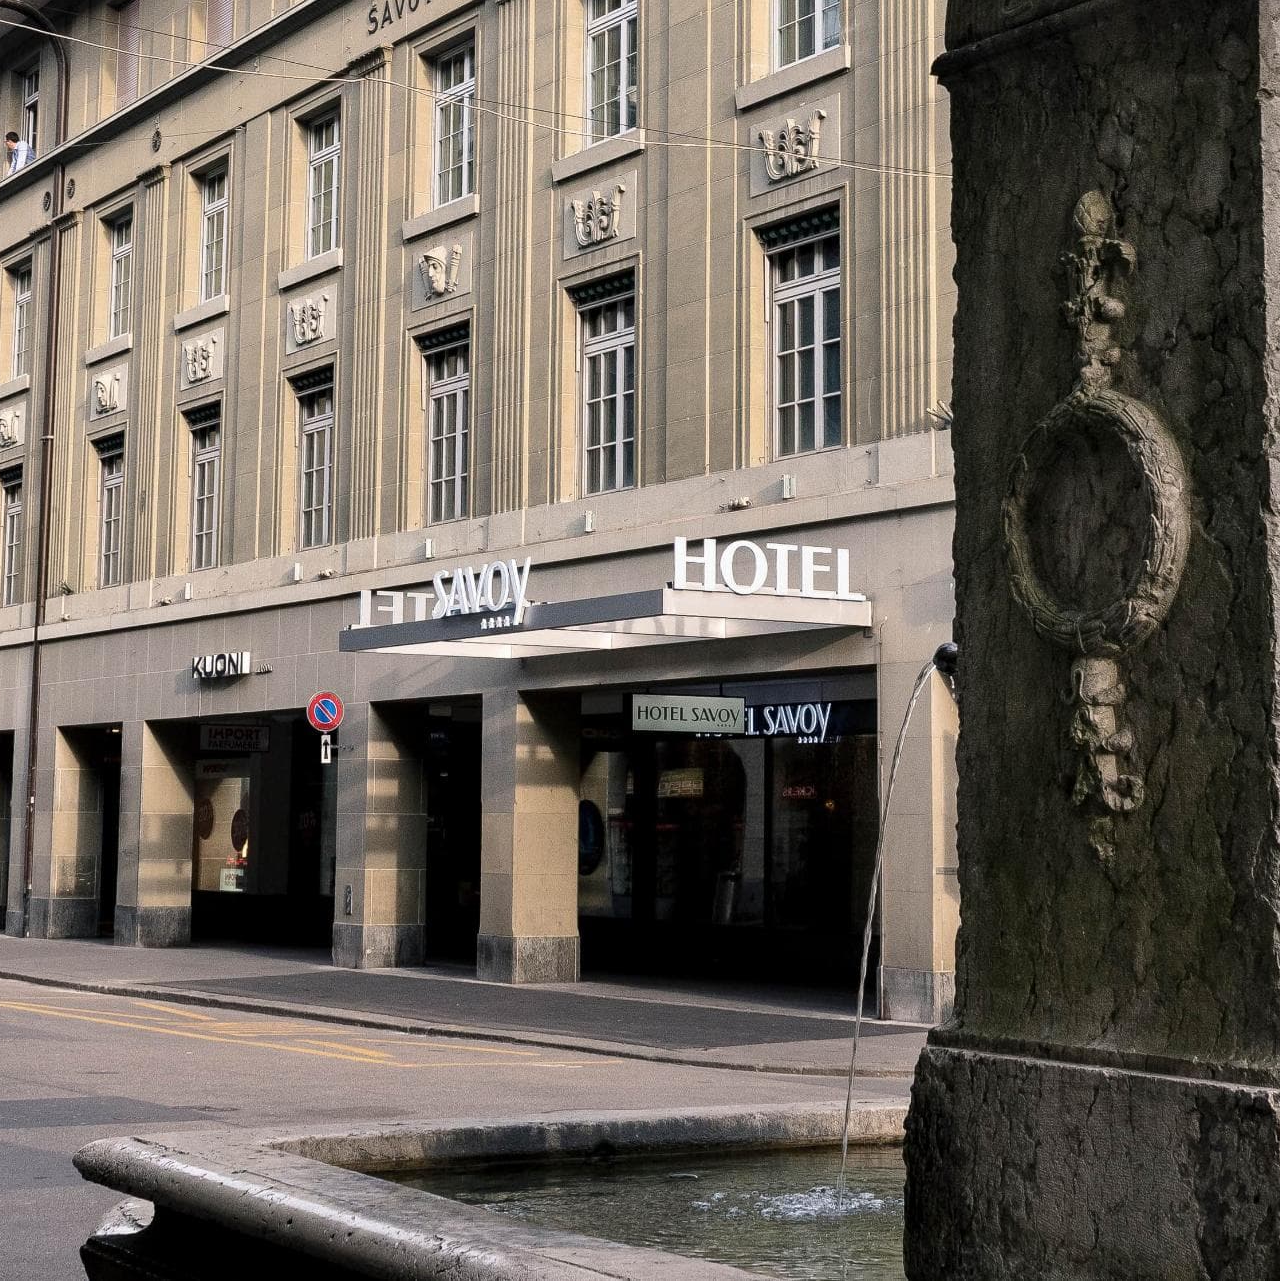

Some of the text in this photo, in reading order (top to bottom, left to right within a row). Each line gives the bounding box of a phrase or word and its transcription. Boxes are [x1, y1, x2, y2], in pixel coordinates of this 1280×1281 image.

[674, 536, 867, 602] HOTEL
[432, 556, 531, 626] SAVOY
[192, 652, 250, 678] KUONI
[637, 705, 688, 722] HOTEL
[691, 707, 740, 727] SAVOY
[763, 703, 832, 742] SAVOY
[208, 728, 262, 740] IMPORT
